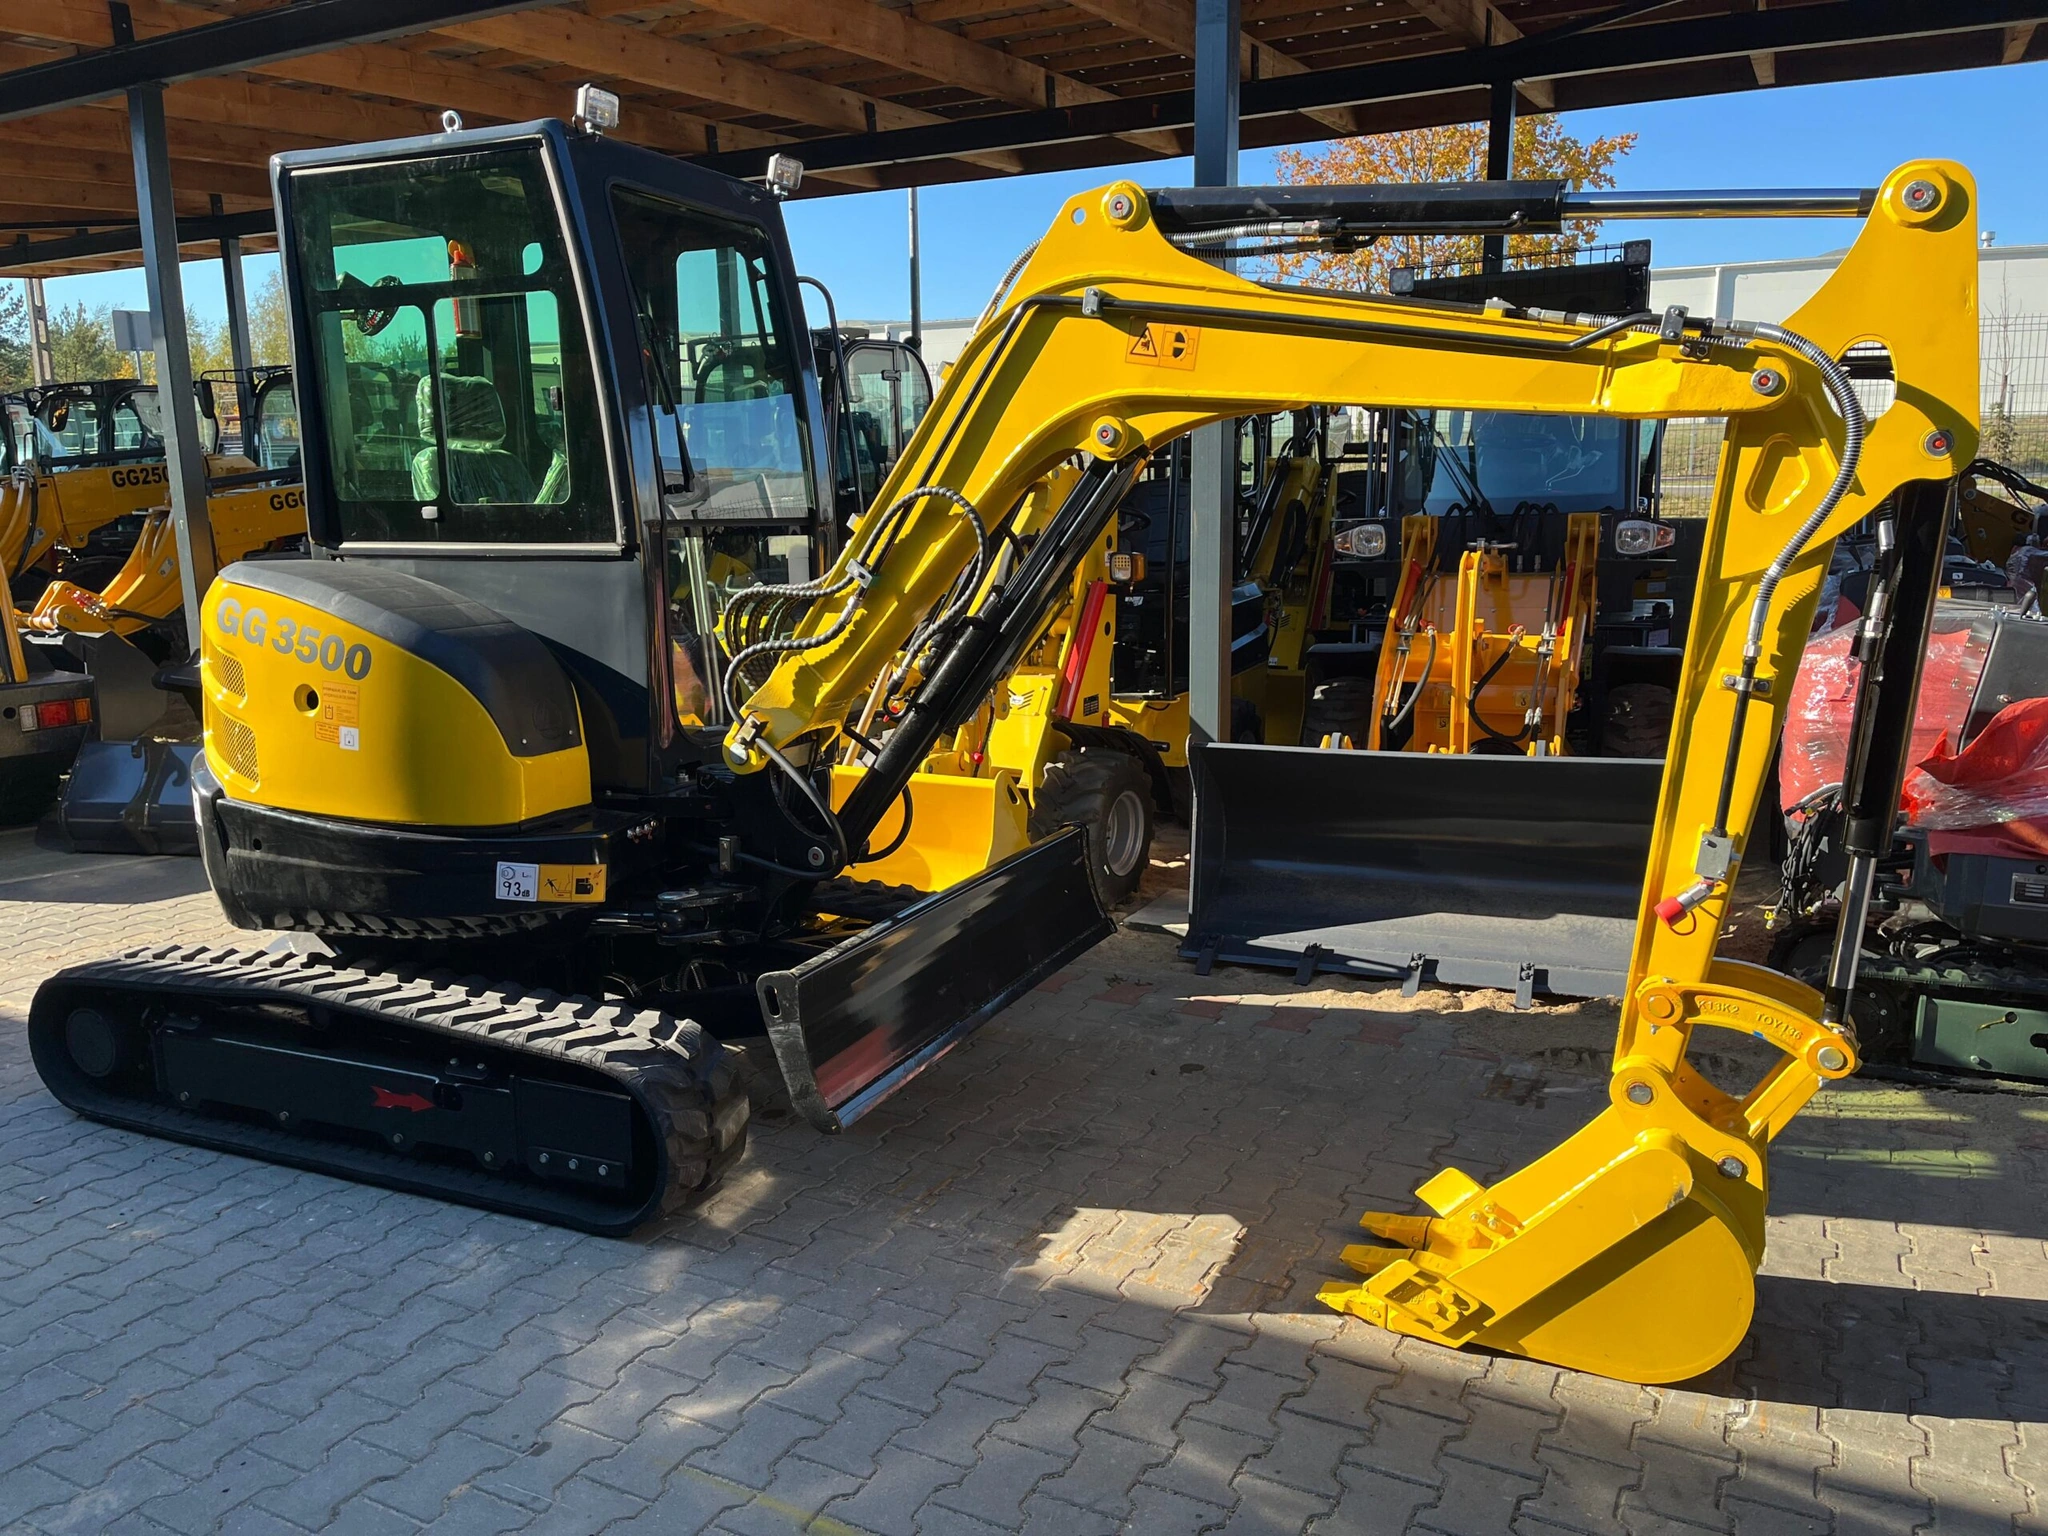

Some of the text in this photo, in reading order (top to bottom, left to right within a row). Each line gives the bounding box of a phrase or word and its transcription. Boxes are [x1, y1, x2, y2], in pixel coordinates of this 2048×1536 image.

[217, 598, 372, 681] GG 3500
[503, 881, 521, 896] 93
